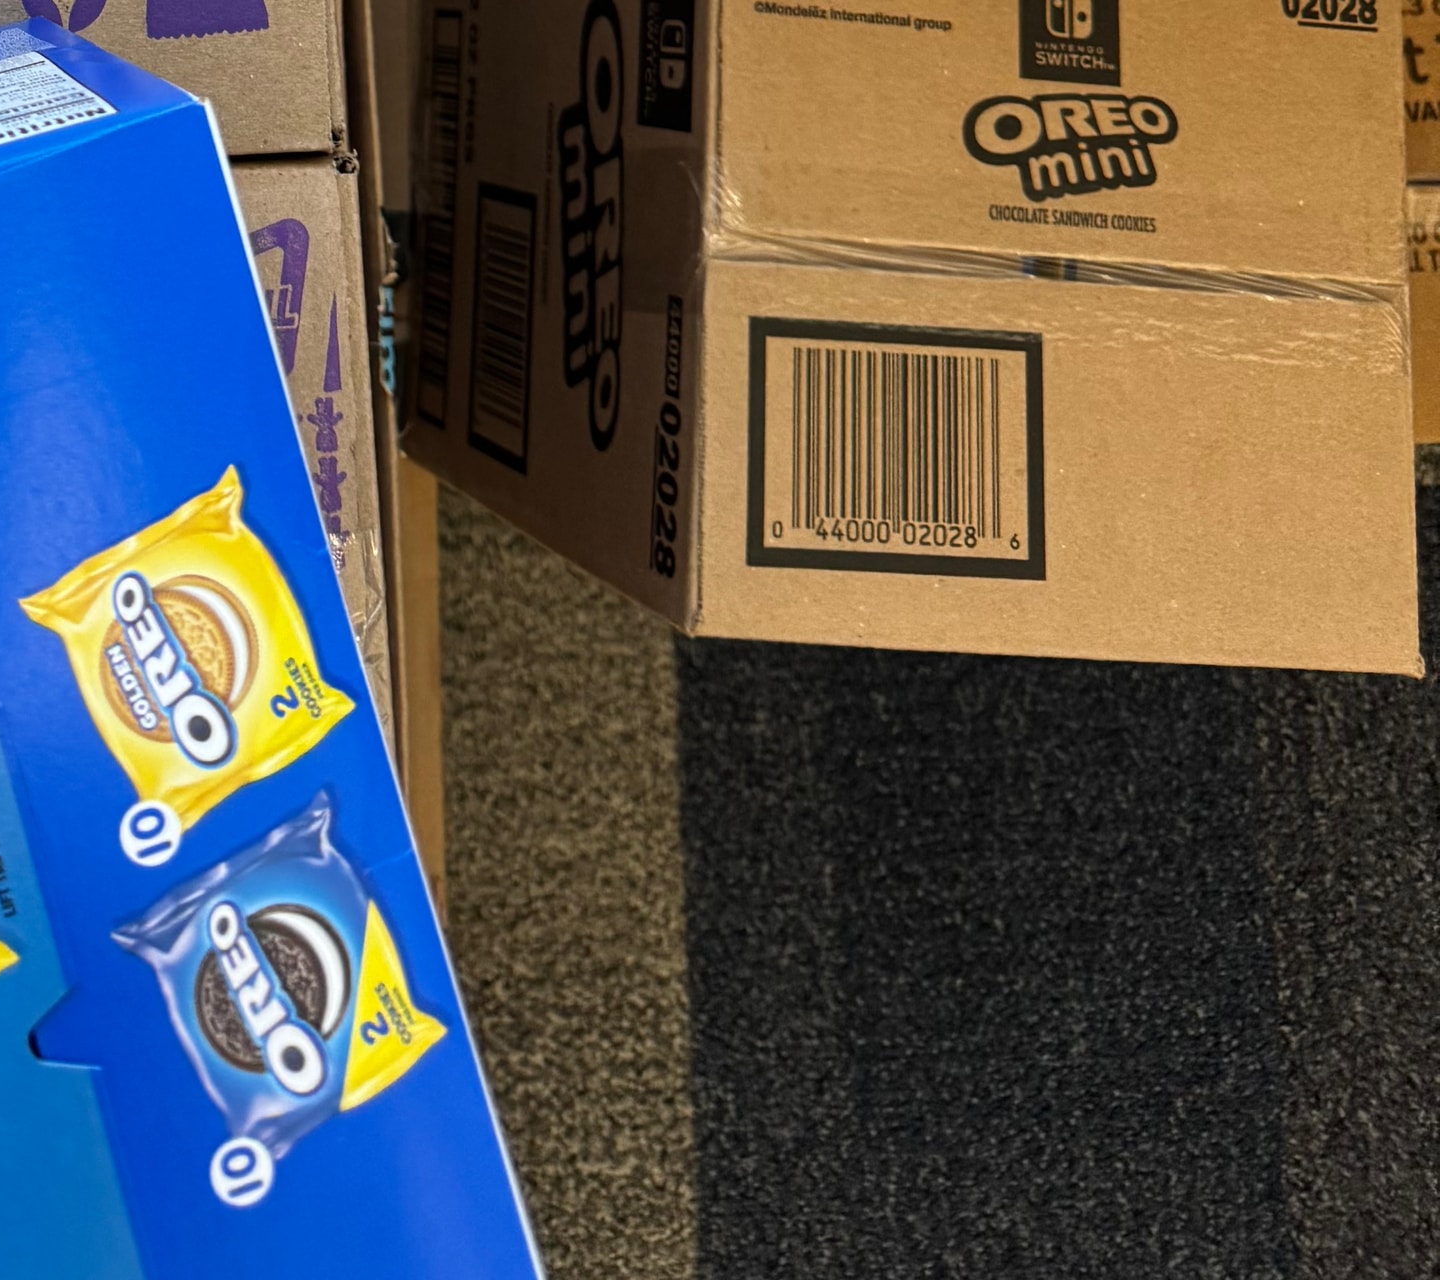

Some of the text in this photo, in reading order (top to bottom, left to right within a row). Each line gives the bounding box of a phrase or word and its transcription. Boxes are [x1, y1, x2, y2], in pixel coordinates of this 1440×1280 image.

[830, 8, 952, 32] International group
[1034, 42, 1105, 56] NINTENDO
[973, 98, 1170, 156] OREO
[1028, 138, 1150, 192] mini
[584, 13, 622, 426] OREO
[988, 203, 1158, 233] CHOCOLATE SANDWICH COOKIES
[656, 402, 682, 578] 02028
[815, 518, 979, 550] 44000 02028
[105, 644, 159, 733] GOLDEN
[112, 573, 237, 768] OREO
[284, 657, 324, 719] COOKIES
[271, 689, 300, 719] 2
[126, 806, 173, 860] 10
[0, 884, 15, 918] LIFT
[207, 902, 327, 1097] OREO
[360, 1011, 391, 1046] 2
[217, 1145, 265, 1198] 10
